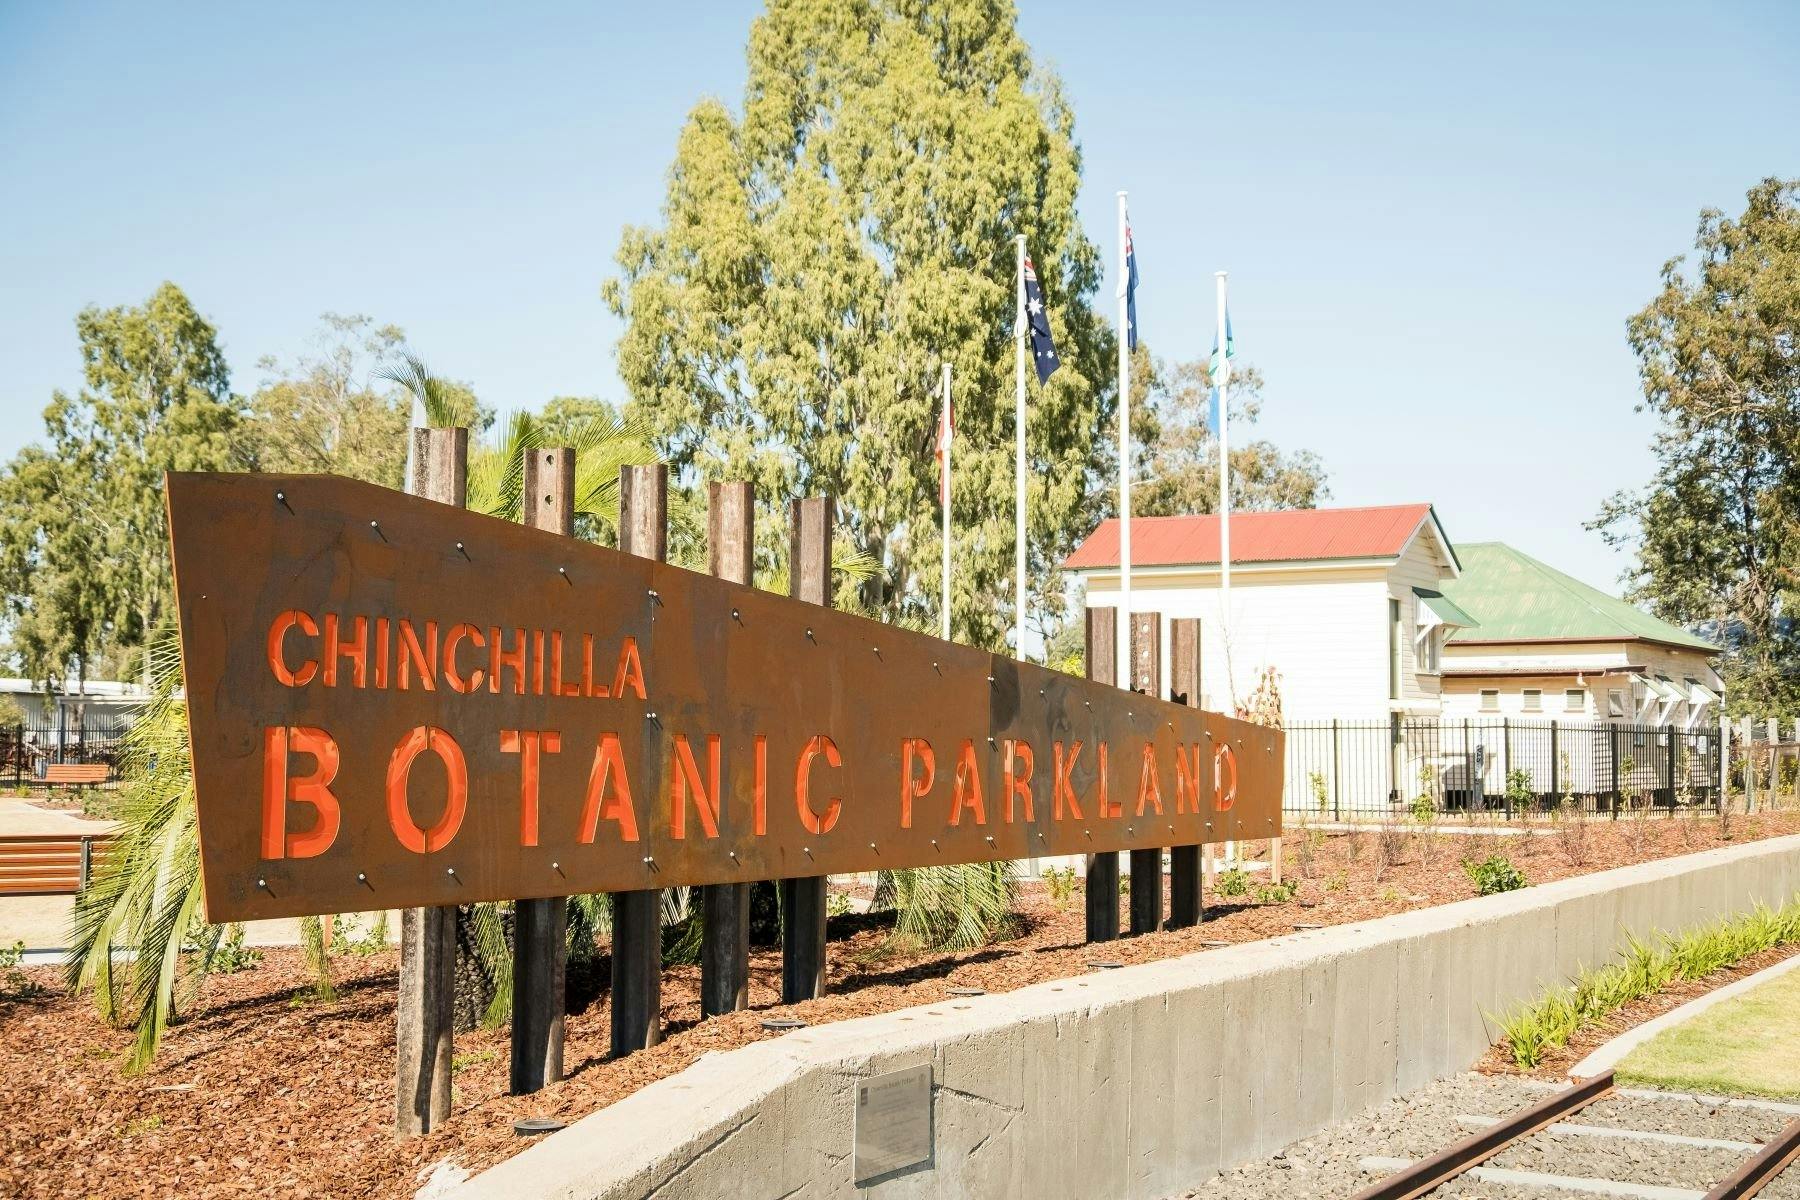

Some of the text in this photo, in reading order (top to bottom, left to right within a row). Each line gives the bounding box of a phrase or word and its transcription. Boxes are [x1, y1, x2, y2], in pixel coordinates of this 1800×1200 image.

[267, 609, 648, 699] CHINCHILLA
[261, 725, 1238, 859] BOTANIC PARKLAND
